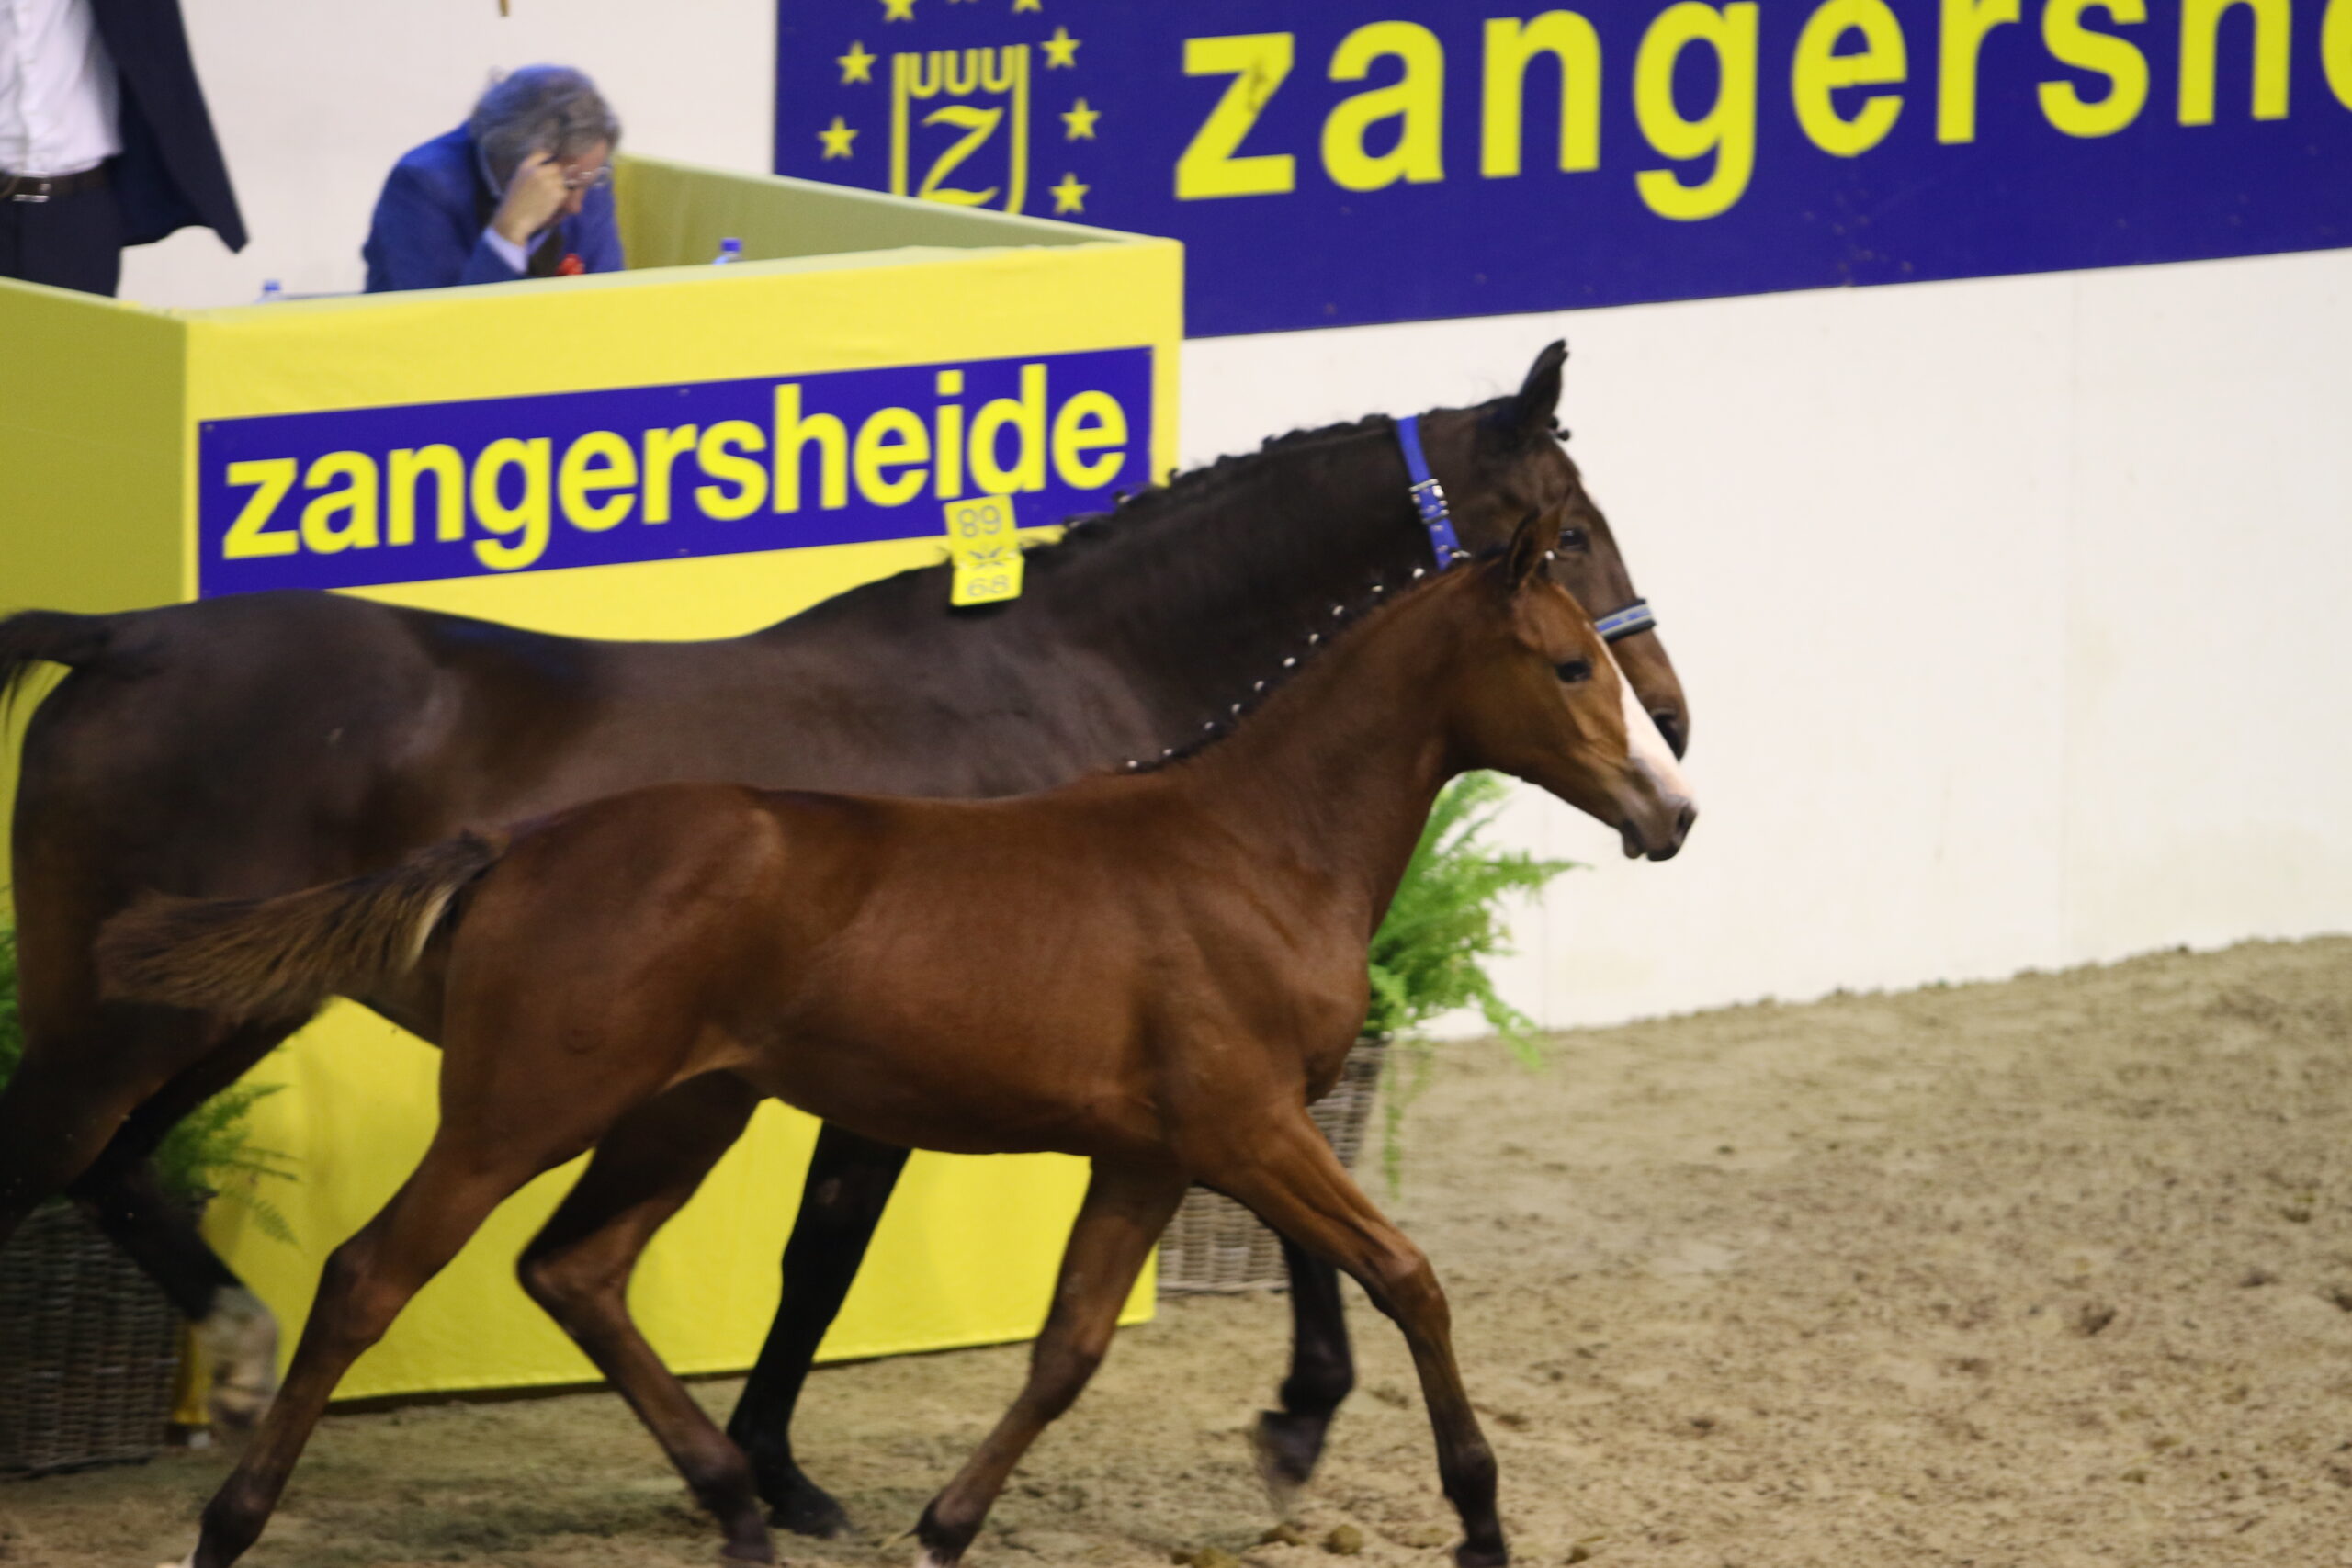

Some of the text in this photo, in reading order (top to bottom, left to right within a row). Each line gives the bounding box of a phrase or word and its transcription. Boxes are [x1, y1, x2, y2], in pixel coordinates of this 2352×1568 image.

[1175, 0, 2352, 221] zangersh
[222, 364, 1128, 571] zangersheide
[957, 504, 1001, 538] 89
